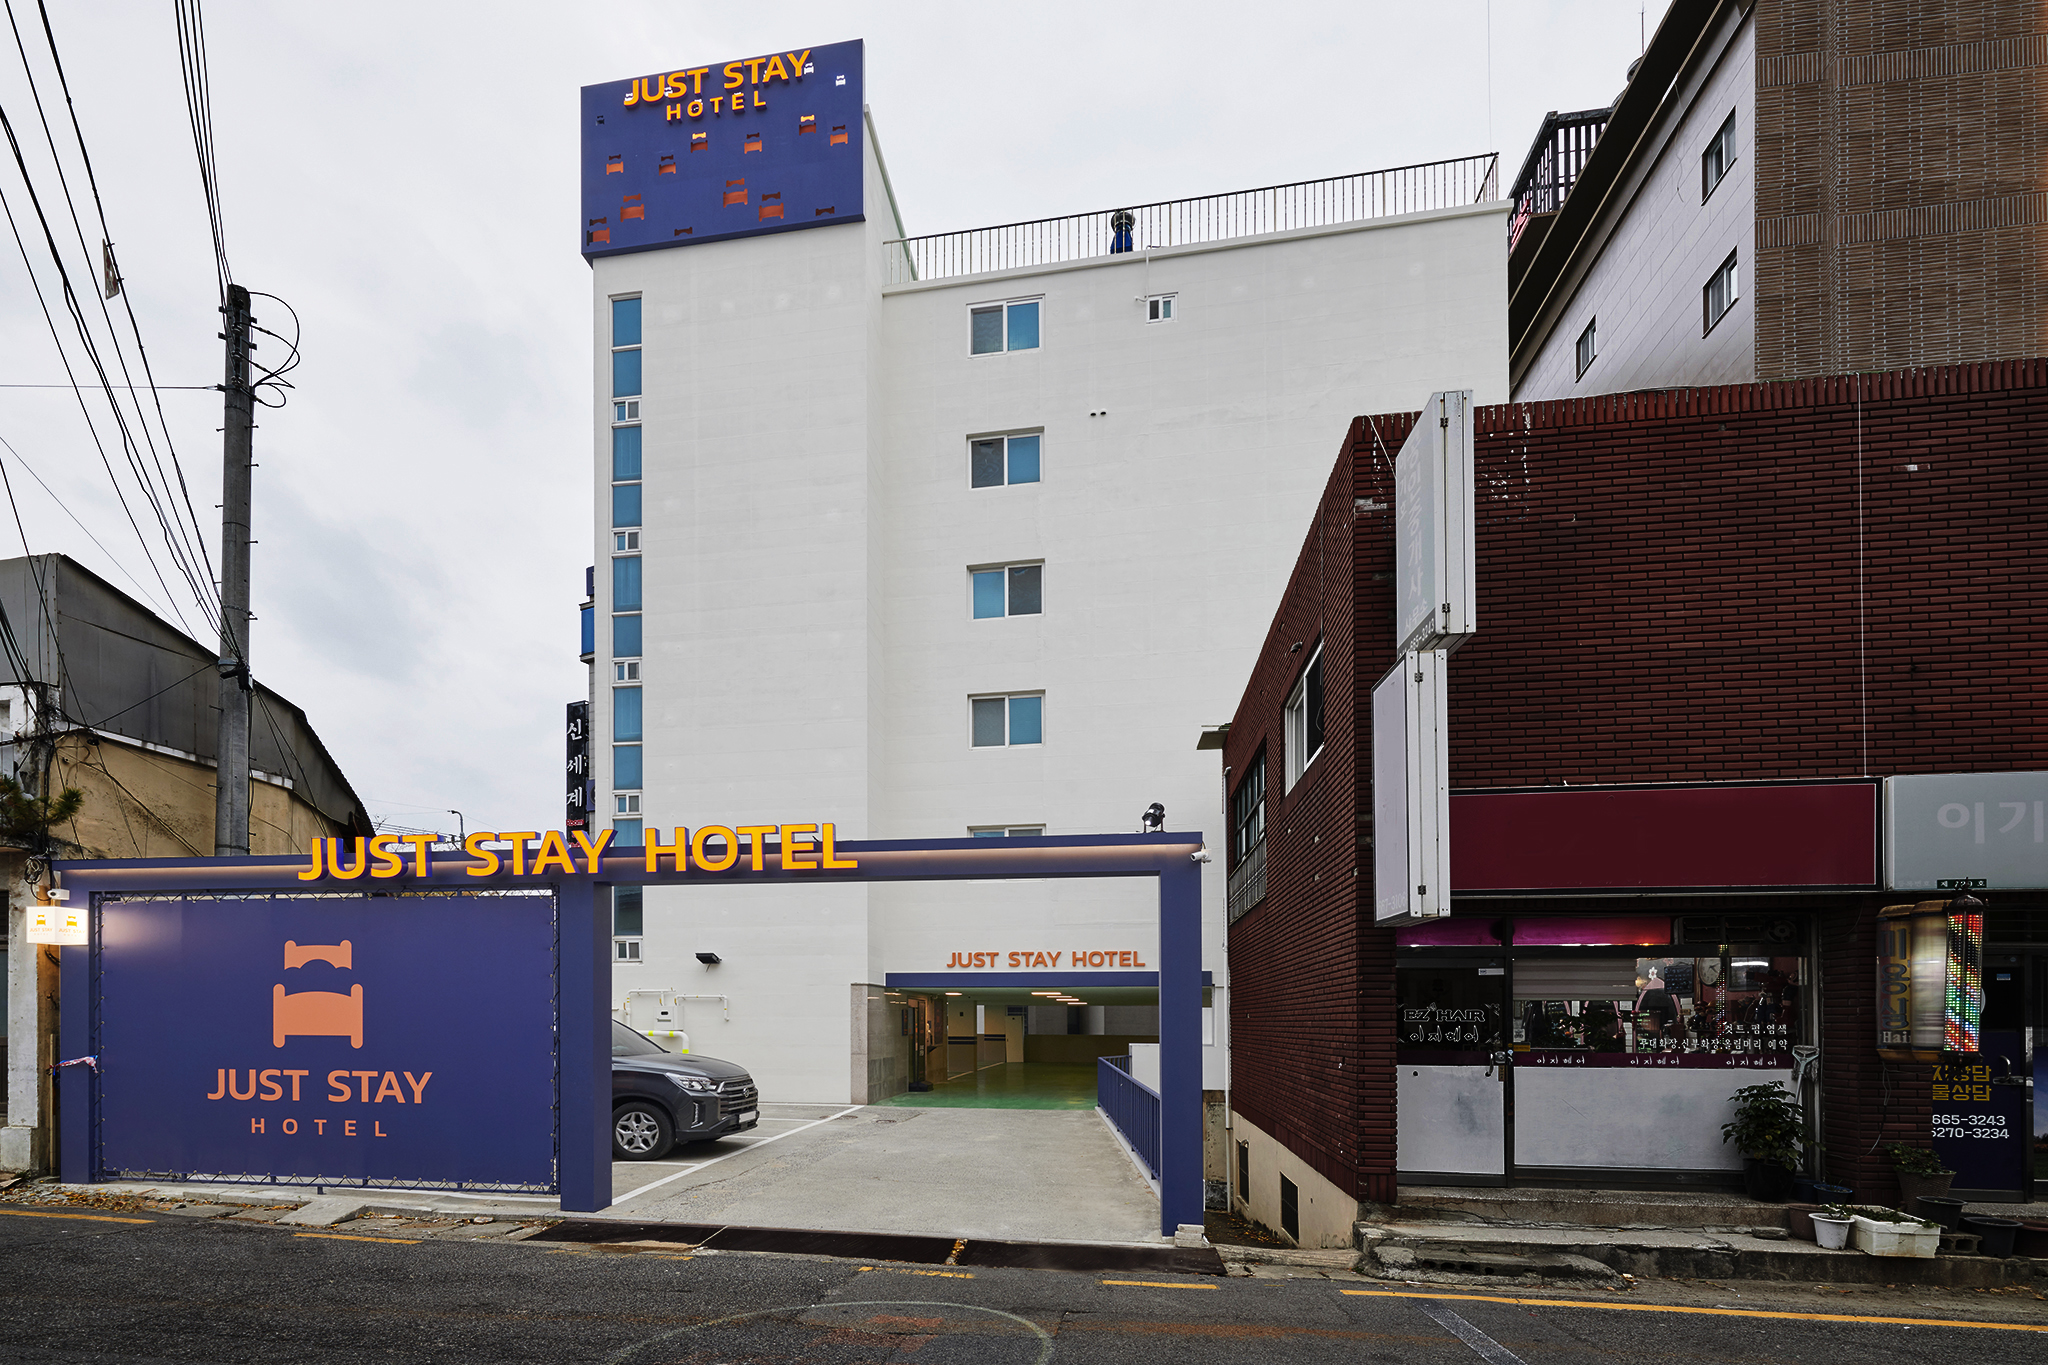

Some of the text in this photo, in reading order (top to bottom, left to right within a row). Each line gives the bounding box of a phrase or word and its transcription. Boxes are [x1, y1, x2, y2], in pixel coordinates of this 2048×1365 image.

[623, 49, 812, 107] JUST STAY
[666, 90, 767, 121] HOTEL
[566, 717, 583, 808] 신세계
[1936, 800, 2046, 845] 이기
[298, 822, 860, 882] JUST STAY HOTEL
[946, 950, 1146, 969] JUST STAY HOTEL
[1403, 1008, 1486, 1023] EZ HAIR
[207, 1068, 433, 1105] JUST STAY
[1931, 1083, 1992, 1102] 물상담
[250, 1117, 388, 1138] HOTEL
[1931, 1113, 2006, 1126] 665-3243
